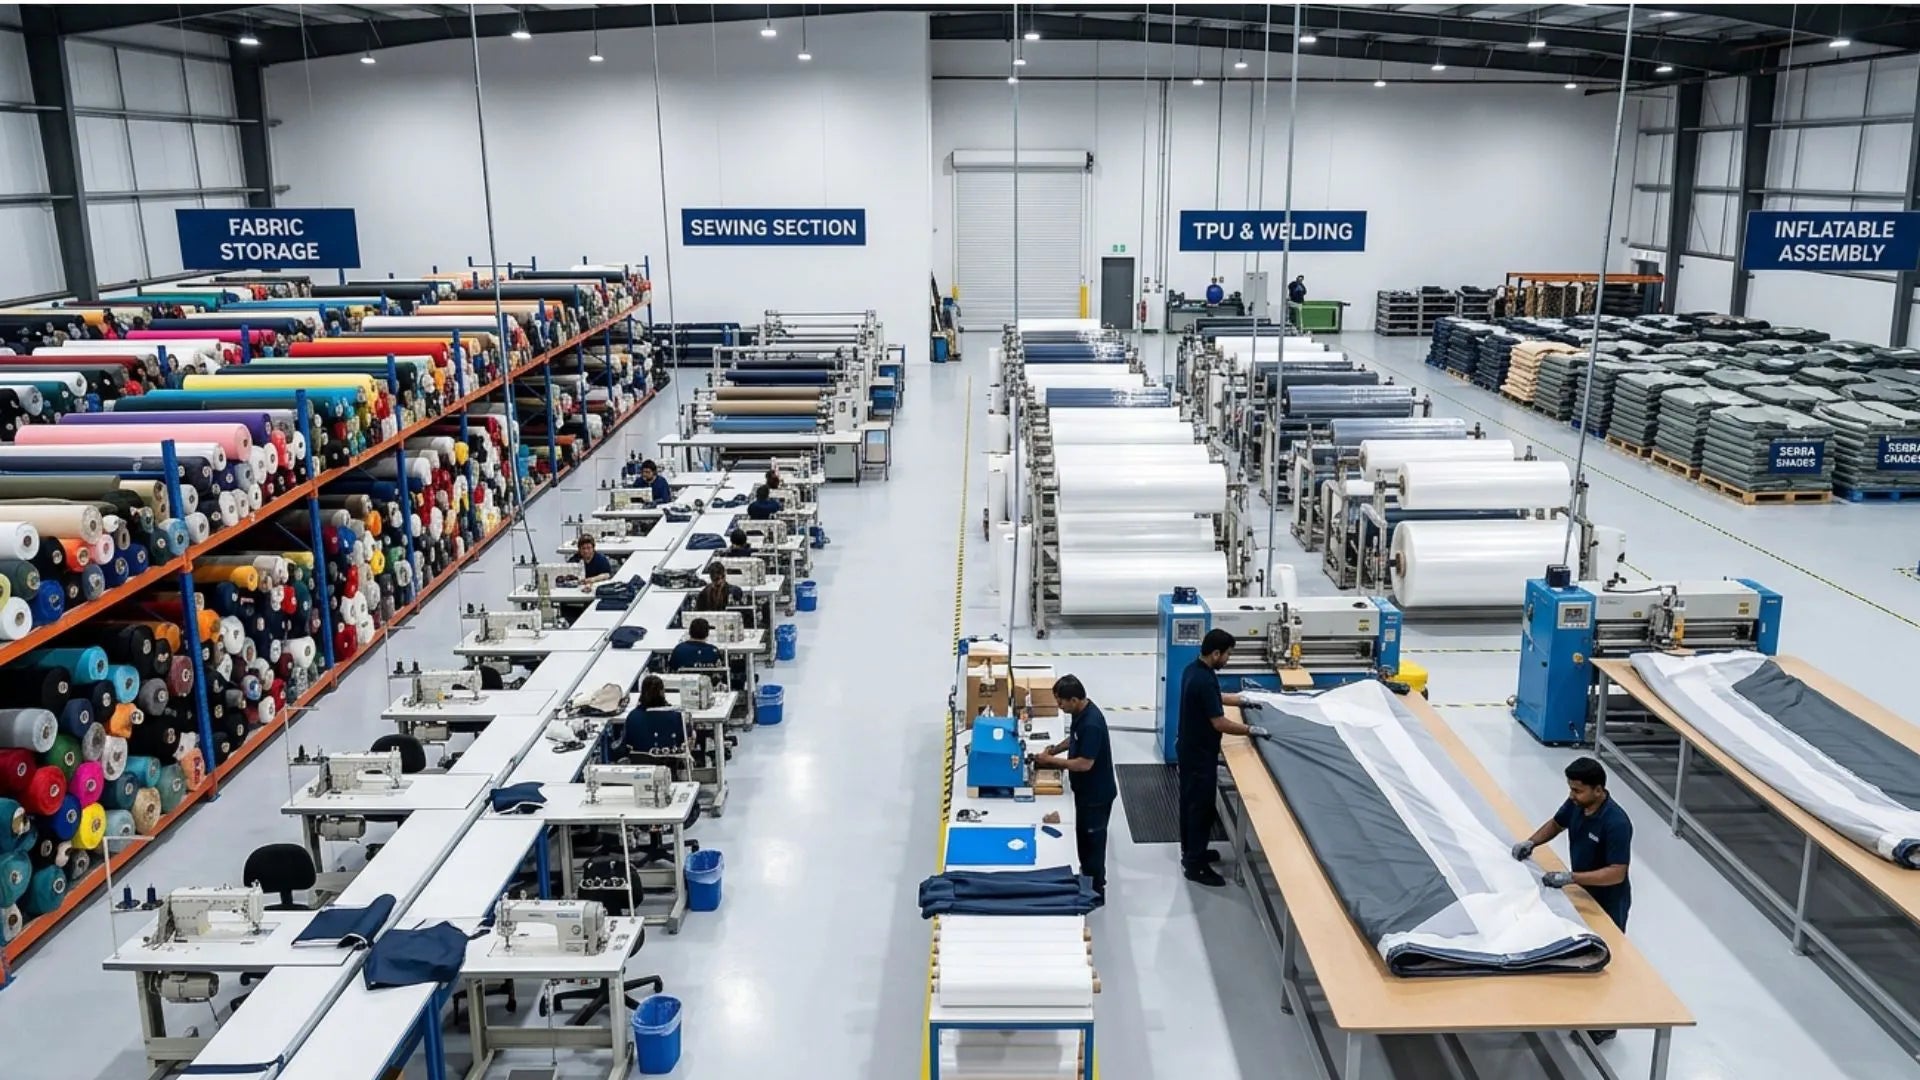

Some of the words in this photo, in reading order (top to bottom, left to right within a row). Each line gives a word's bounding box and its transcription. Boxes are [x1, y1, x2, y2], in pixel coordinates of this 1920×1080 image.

[228, 218, 304, 237] FABRIC
[690, 219, 767, 237] SEWING
[772, 219, 857, 237] SECTION
[1192, 222, 1234, 240] TPU
[1239, 222, 1254, 240] &
[1259, 222, 1353, 240] WELDING
[1774, 220, 1895, 239] INFLATABLE
[220, 242, 320, 262] STORAGE
[1778, 244, 1886, 262] ASSEMBLY
[1779, 446, 1816, 457] SERRA
